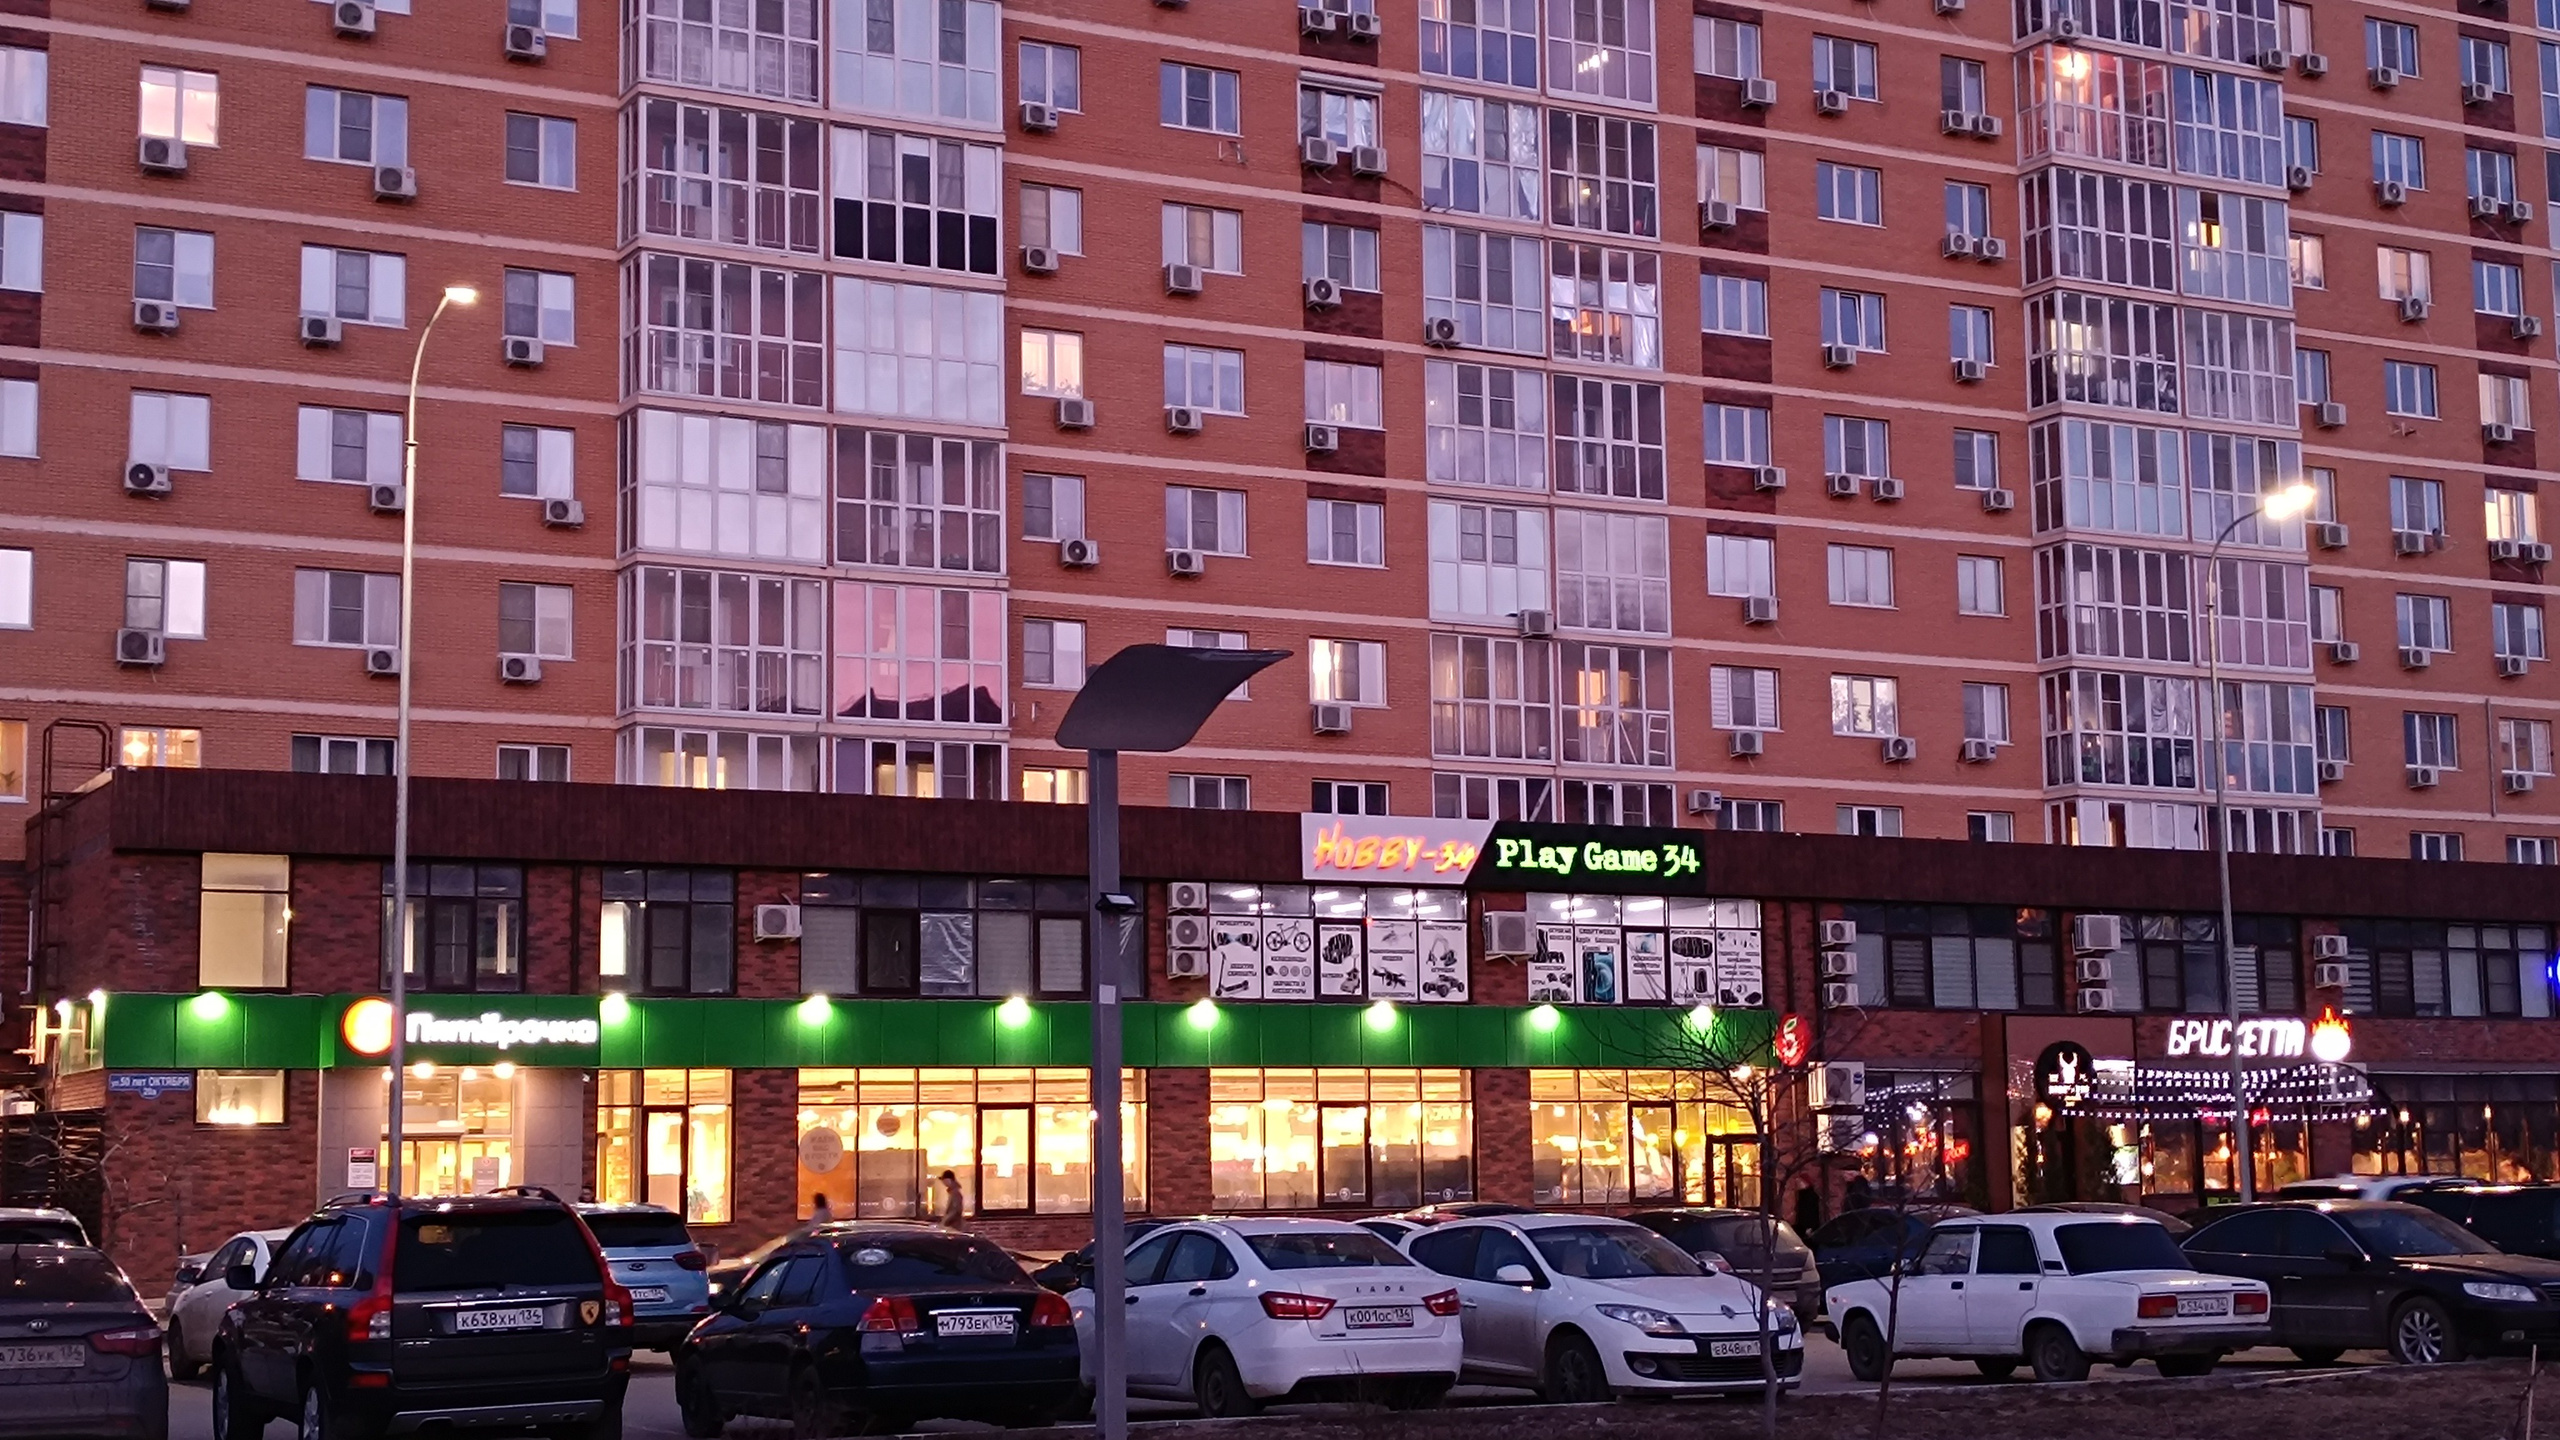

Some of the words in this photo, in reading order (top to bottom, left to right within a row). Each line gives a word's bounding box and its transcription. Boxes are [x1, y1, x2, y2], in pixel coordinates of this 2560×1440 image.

[1314, 821, 1478, 873] HOBBY-34
[1495, 838, 1577, 876] Play
[1583, 841, 1658, 873] Game
[1662, 844, 1701, 878] 34
[405, 1011, 599, 1050] Пятёрочка
[148, 1077, 190, 1087] ОКТЯБРЯ
[461, 1313, 517, 1327] К638ХН
[519, 1310, 541, 1324] 134
